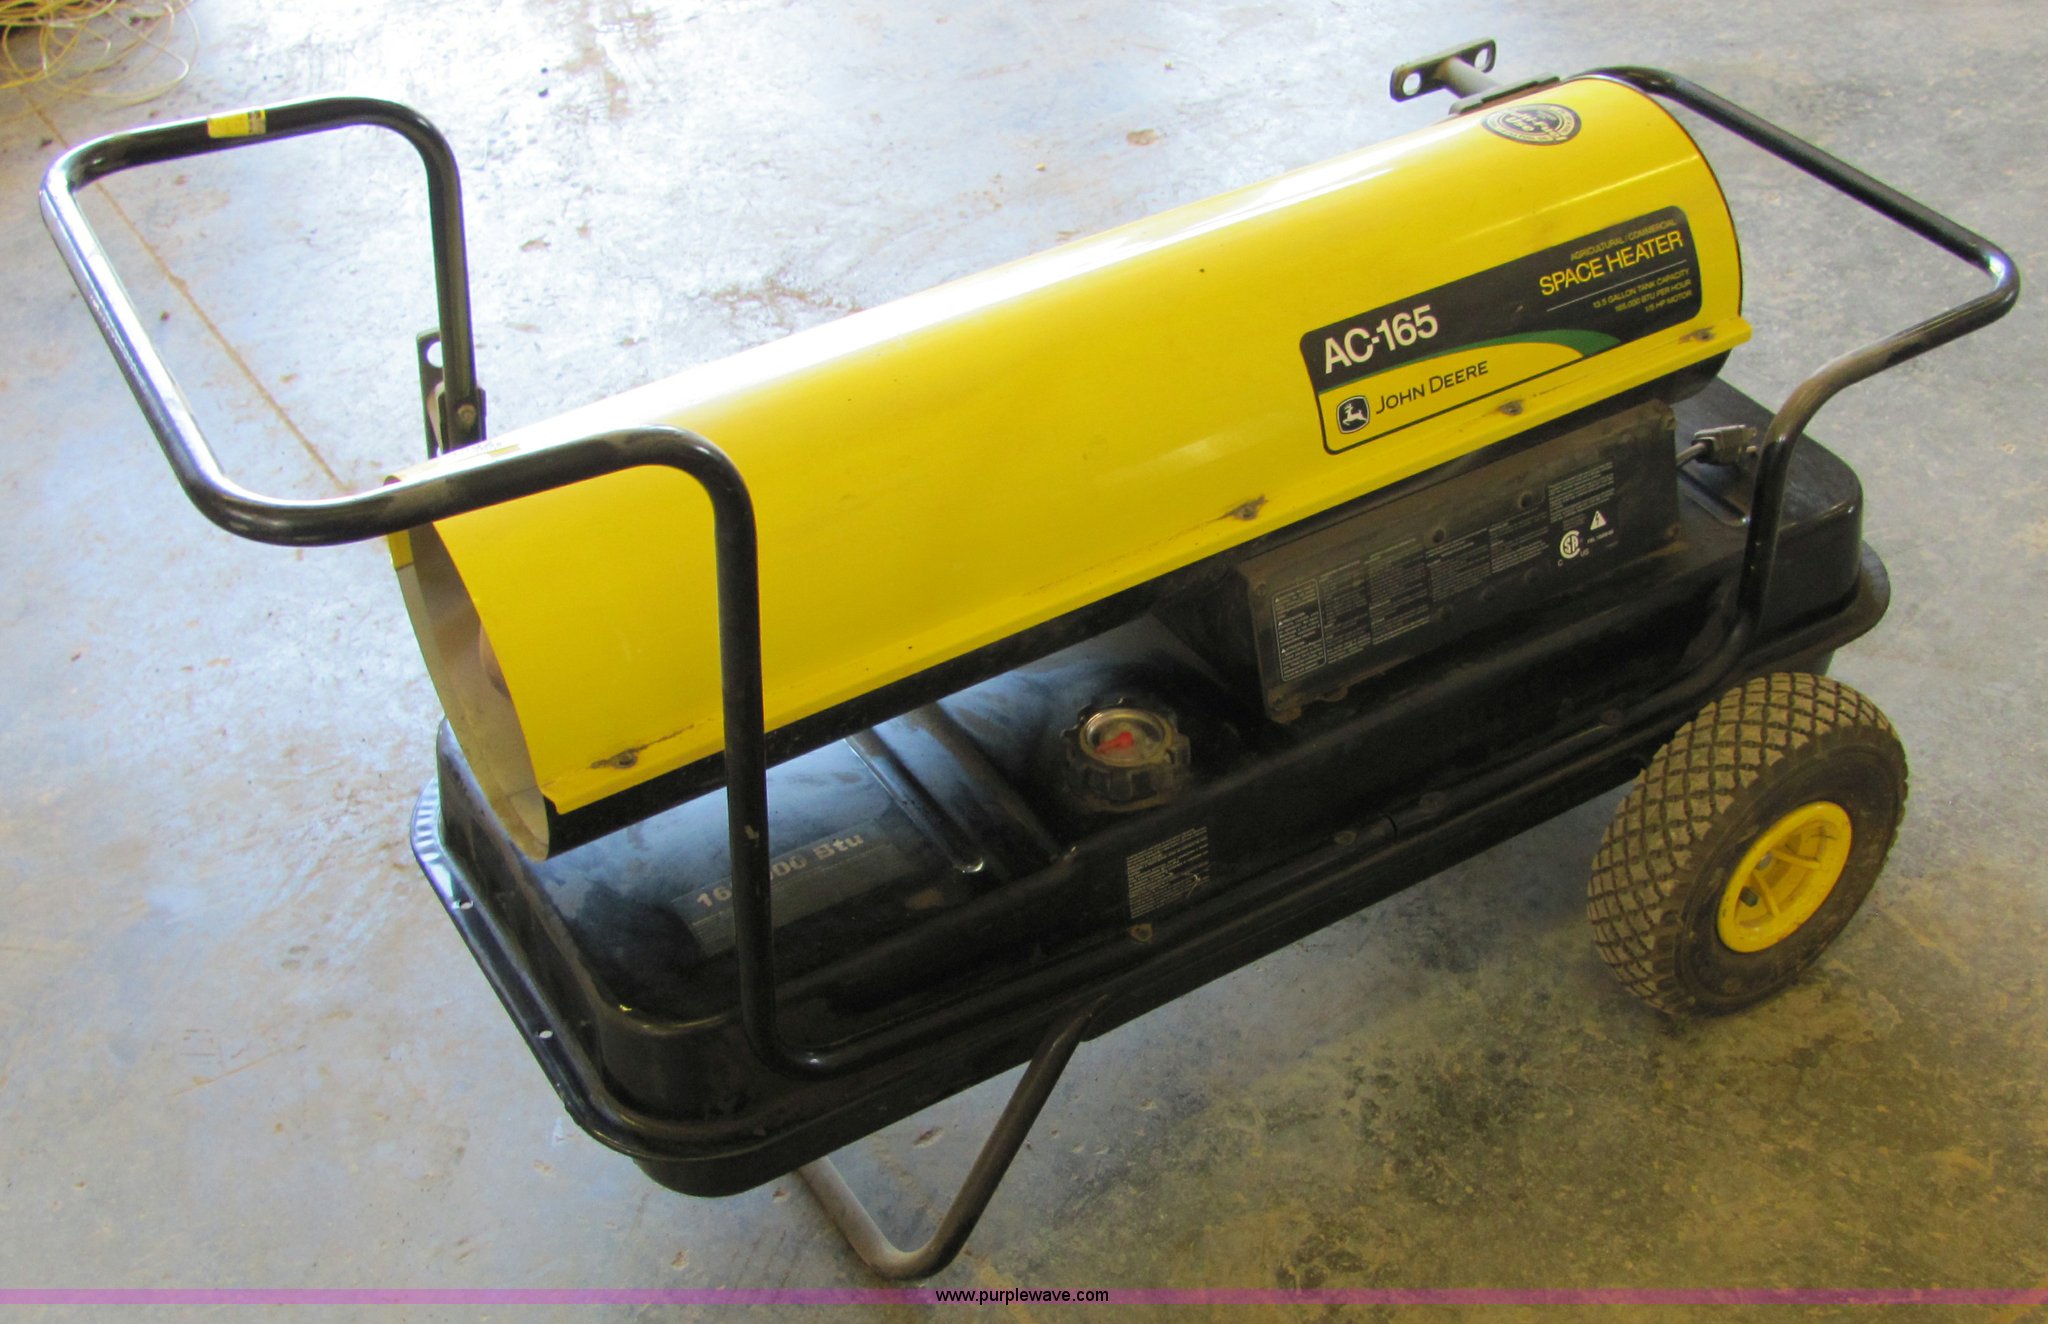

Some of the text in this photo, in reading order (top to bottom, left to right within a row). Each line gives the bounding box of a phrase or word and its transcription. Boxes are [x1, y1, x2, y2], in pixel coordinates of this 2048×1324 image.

[1571, 237, 1624, 261] AGRICULTURAL
[1627, 219, 1675, 240] COMMERCIAL
[1539, 230, 1684, 296] SPACE HEATER
[1607, 288, 1636, 304] GALLON
[1637, 281, 1656, 292] TANK
[1656, 267, 1690, 286] CAPACITY
[1641, 292, 1656, 304] BTU
[1656, 286, 1670, 297] PER
[1670, 279, 1692, 291] HOUR
[1666, 289, 1692, 304] MOTOR
[1324, 305, 1438, 374] AC-165
[1376, 361, 1489, 415] JOHN DEERE
[812, 834, 864, 861] Btu
